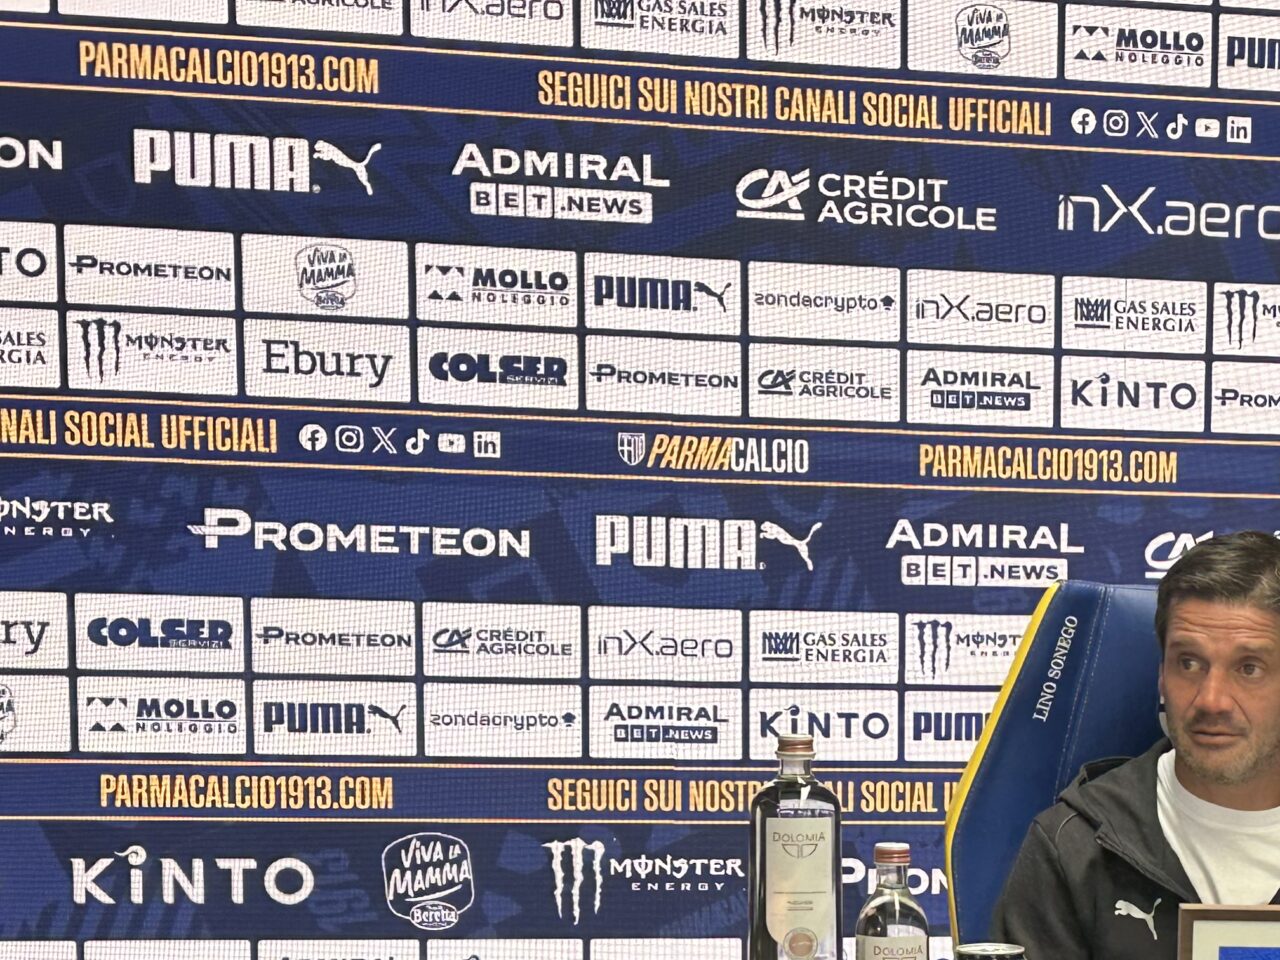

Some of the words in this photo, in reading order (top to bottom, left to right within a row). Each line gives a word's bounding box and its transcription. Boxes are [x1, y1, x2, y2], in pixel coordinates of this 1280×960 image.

[640, 16, 728, 35] ENERGIA
[1115, 28, 1204, 52] MOLLO
[80, 41, 379, 93] PARMACALCIO1913.COM
[1115, 52, 1204, 67] NOLEGGIO
[537, 70, 631, 111] SEGUICI
[638, 80, 677, 114] SUI
[685, 82, 767, 119] NOSTRI
[775, 87, 856, 126] CANALI
[863, 92, 942, 130] SOCIAL
[949, 97, 1052, 136] UFFICIALI
[134, 129, 320, 192] PUMA
[452, 144, 670, 188] ADMIRAL
[818, 170, 948, 201] CRÉDIT
[818, 200, 997, 231] AGRICOLE
[69, 255, 232, 282] PROMETEON
[472, 268, 569, 290] MOLLO
[593, 276, 698, 312] PUMA
[754, 291, 878, 311] zondacrypto
[1115, 300, 1144, 316] GAS
[1150, 302, 1196, 317] SALES
[1115, 318, 1197, 332] ENERGIA
[262, 340, 393, 388] Ebury
[429, 352, 568, 386] COLSER
[589, 365, 738, 388] PROMETEON
[800, 371, 866, 386] CRÉDIT
[921, 368, 1042, 390] ADMIRAL
[800, 385, 891, 399] AGRICOLE
[64, 410, 154, 449] SOCIAL
[161, 414, 277, 453] UFFICIALI
[647, 433, 809, 473] PARMACALCIO
[919, 444, 1177, 483] PARMACALCIO1913.COM
[188, 508, 530, 557] PROMETEON
[596, 515, 765, 571] PUMA
[886, 519, 1084, 553] ADMIRAL
[88, 617, 232, 648] COLSER
[256, 626, 411, 647] PROMETEON
[476, 629, 545, 641] CRÉDIT
[804, 633, 835, 647] GAS
[841, 633, 888, 647] SALES
[476, 643, 571, 655] AGRICOLE
[805, 650, 888, 663] ENERGIA
[1032, 682, 1057, 722] LINO
[1048, 615, 1078, 679] SONEGO
[136, 699, 237, 718] MOLLO
[264, 703, 371, 734] PUMA
[430, 711, 558, 728] zondacrypto
[604, 704, 729, 722] ADMIRAL
[100, 774, 393, 808] PARMACALCIO1913.COM
[548, 778, 636, 811] SEGUICI
[644, 780, 681, 811] SUI
[861, 782, 937, 811] SOCIAL
[772, 832, 825, 842] DOLOMIA
[388, 860, 470, 900] MAMMA
[632, 882, 724, 891] ENERGY
[874, 945, 923, 956] DOLOMIA
